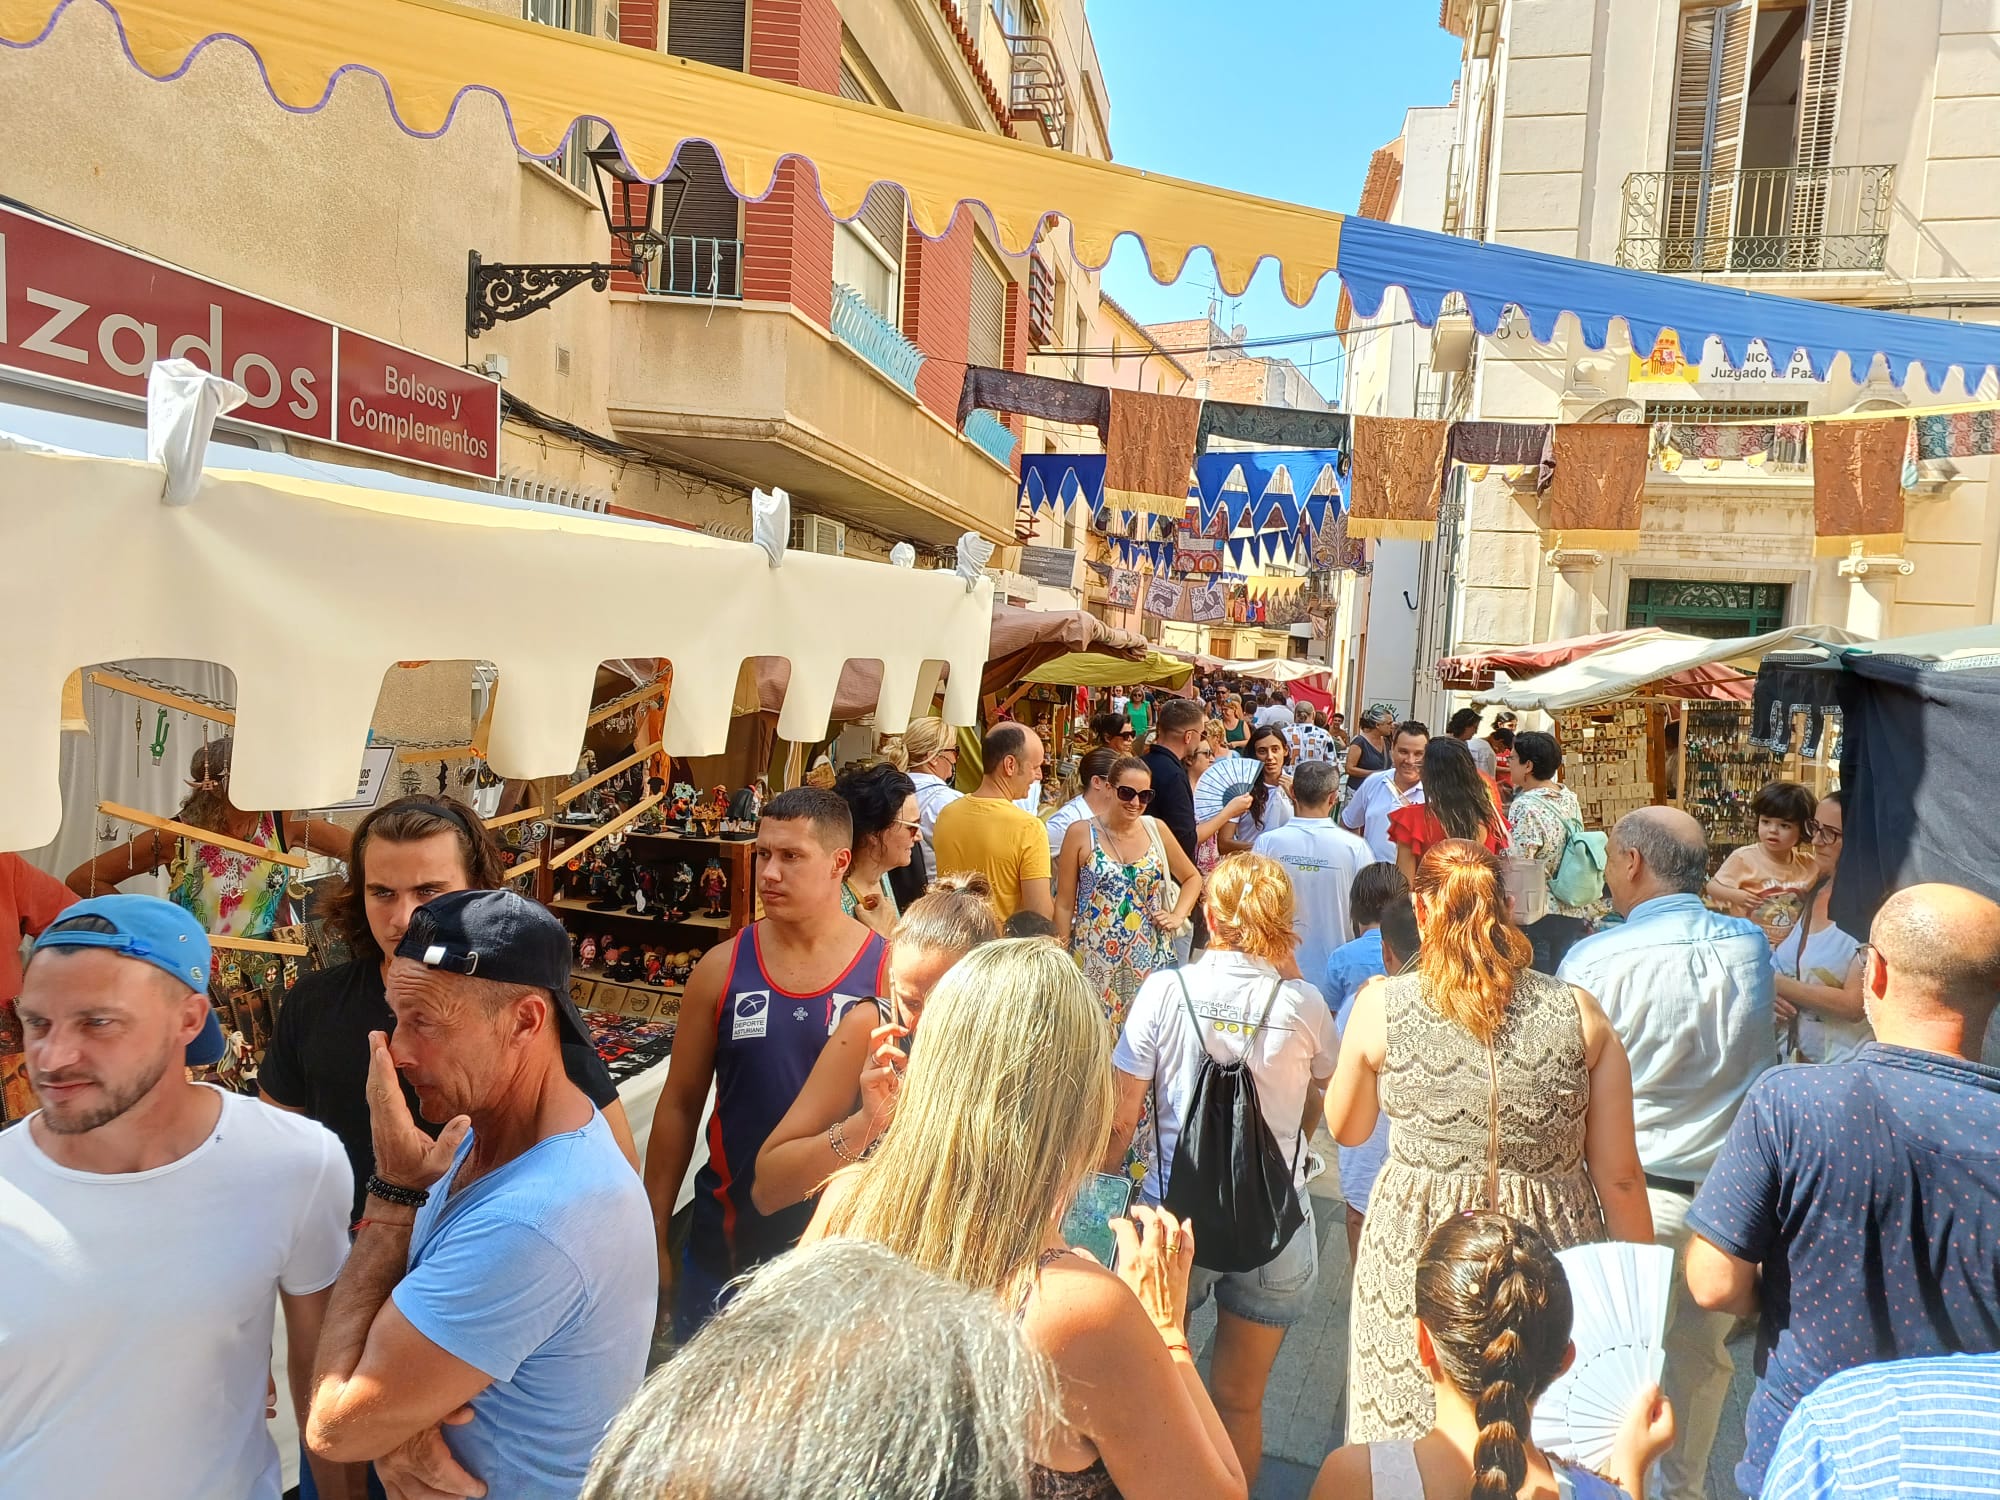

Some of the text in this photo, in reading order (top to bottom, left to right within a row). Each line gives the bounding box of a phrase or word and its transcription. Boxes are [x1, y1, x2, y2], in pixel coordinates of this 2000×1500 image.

[1711, 366, 1767, 381] Juzgado
[384, 364, 462, 420] Bolsos y
[349, 396, 489, 460] Complementos
[734, 1020, 765, 1028] DEPORTE
